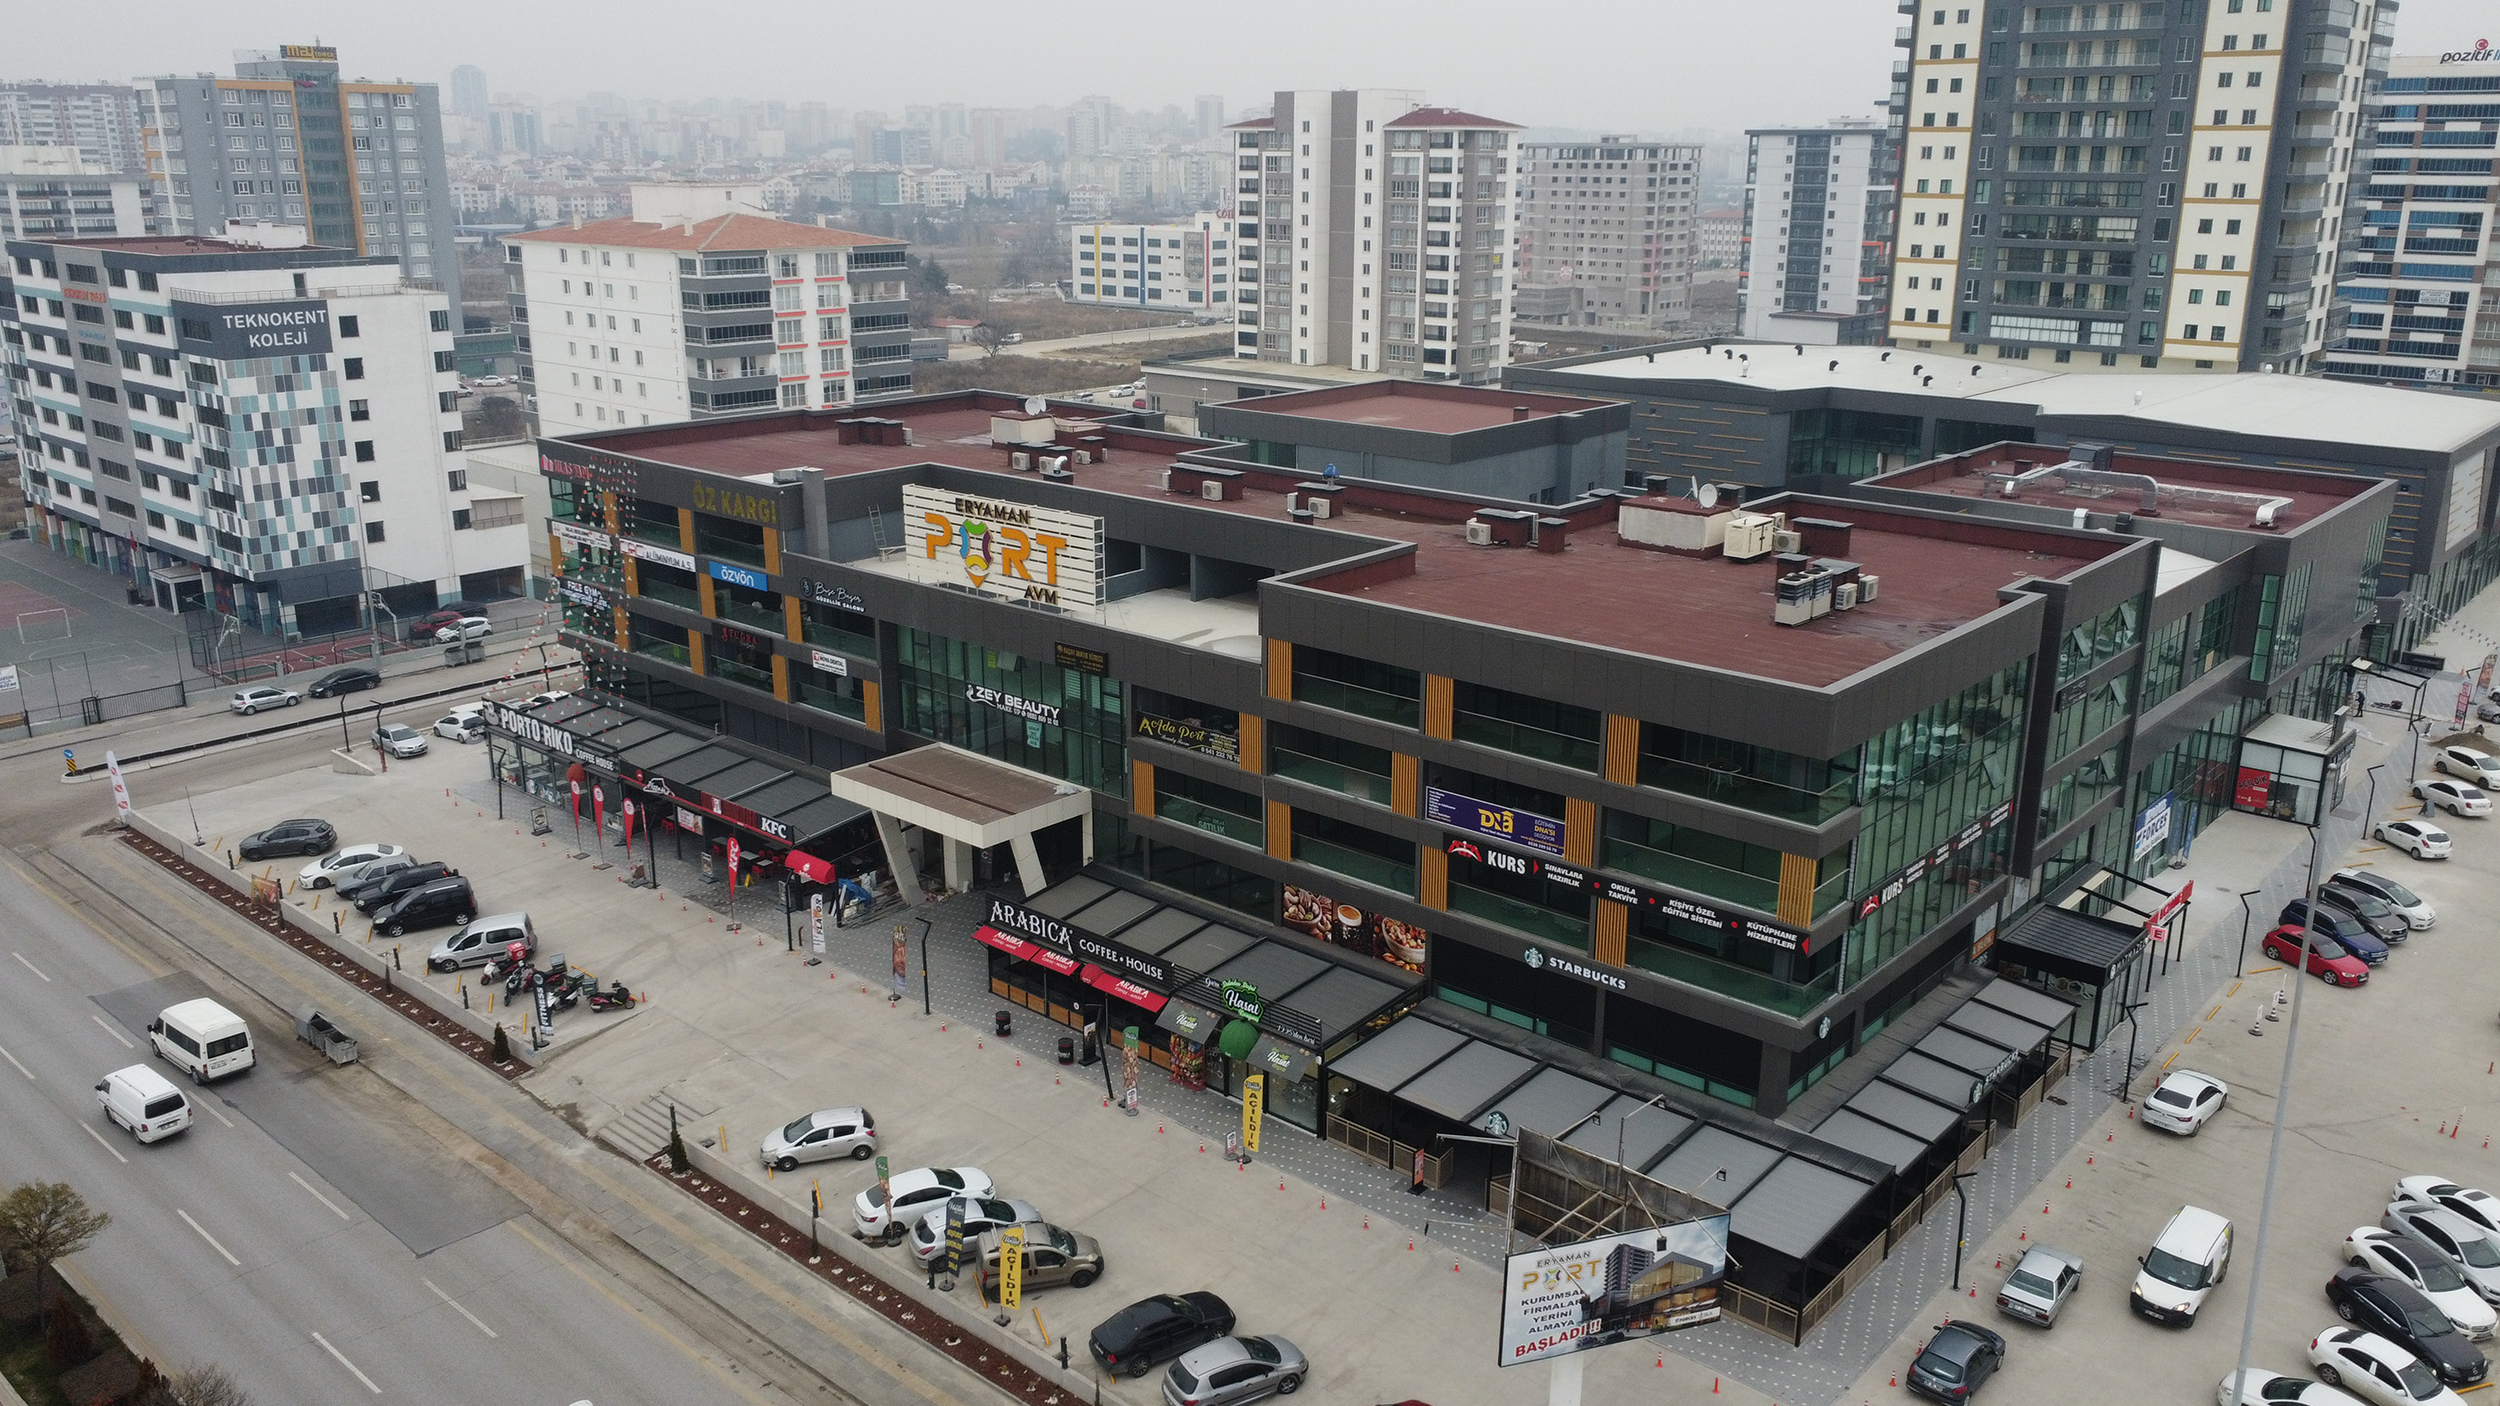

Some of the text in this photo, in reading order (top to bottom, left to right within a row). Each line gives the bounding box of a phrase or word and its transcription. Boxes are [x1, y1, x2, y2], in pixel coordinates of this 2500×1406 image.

[222, 310, 326, 329] TEKNOKENT
[249, 328, 308, 348] KOLEJİ
[693, 481, 777, 524] ÖZ KARGI
[954, 498, 1031, 525] ERYAMAN
[924, 511, 1067, 589] PORT
[1024, 585, 1058, 605] AVM
[975, 686, 1060, 719] ZEY BEAUTY
[500, 707, 615, 771] PORTO RIKO COFFEE HOUSE
[1178, 725, 1208, 741] Port
[761, 817, 787, 839] KFC
[729, 840, 739, 873] KFC
[1487, 850, 1526, 875] KURS
[1544, 863, 1583, 880] SINAVLARA
[1547, 872, 1580, 888] HAZIRLIK
[1608, 890, 1639, 904] TAKVİYE
[1610, 883, 1636, 895] OKULA
[1882, 877, 1903, 905] KURS
[1662, 906, 1723, 929] EĞİTİM SİSTEMİ
[1668, 899, 1717, 918] KİŞİYE ÖZEL
[990, 900, 1164, 980] ARABICA COFFEE HOUSE
[994, 931, 1024, 947] ARABICA
[1746, 921, 1798, 941] KÜTÜPHANE
[1746, 930, 1796, 950] HİZMETLERİ
[2154, 929, 2163, 939] E
[1549, 956, 1626, 990] STARBUCKS
[1116, 980, 1149, 998] ARABICA
[536, 986, 549, 1027] FITNESS
[1225, 989, 1260, 1015] Hasat
[1176, 1014, 1198, 1030] Hasat
[1267, 1051, 1291, 1068] Hasat
[1537, 1251, 1591, 1268] ERYAMAN
[1522, 1259, 1602, 1291] PORT
[1533, 1309, 1572, 1323] YERİNİ
[1528, 1319, 1575, 1334] ALMAYA
[1515, 1325, 1586, 1357] BAŞLADI
